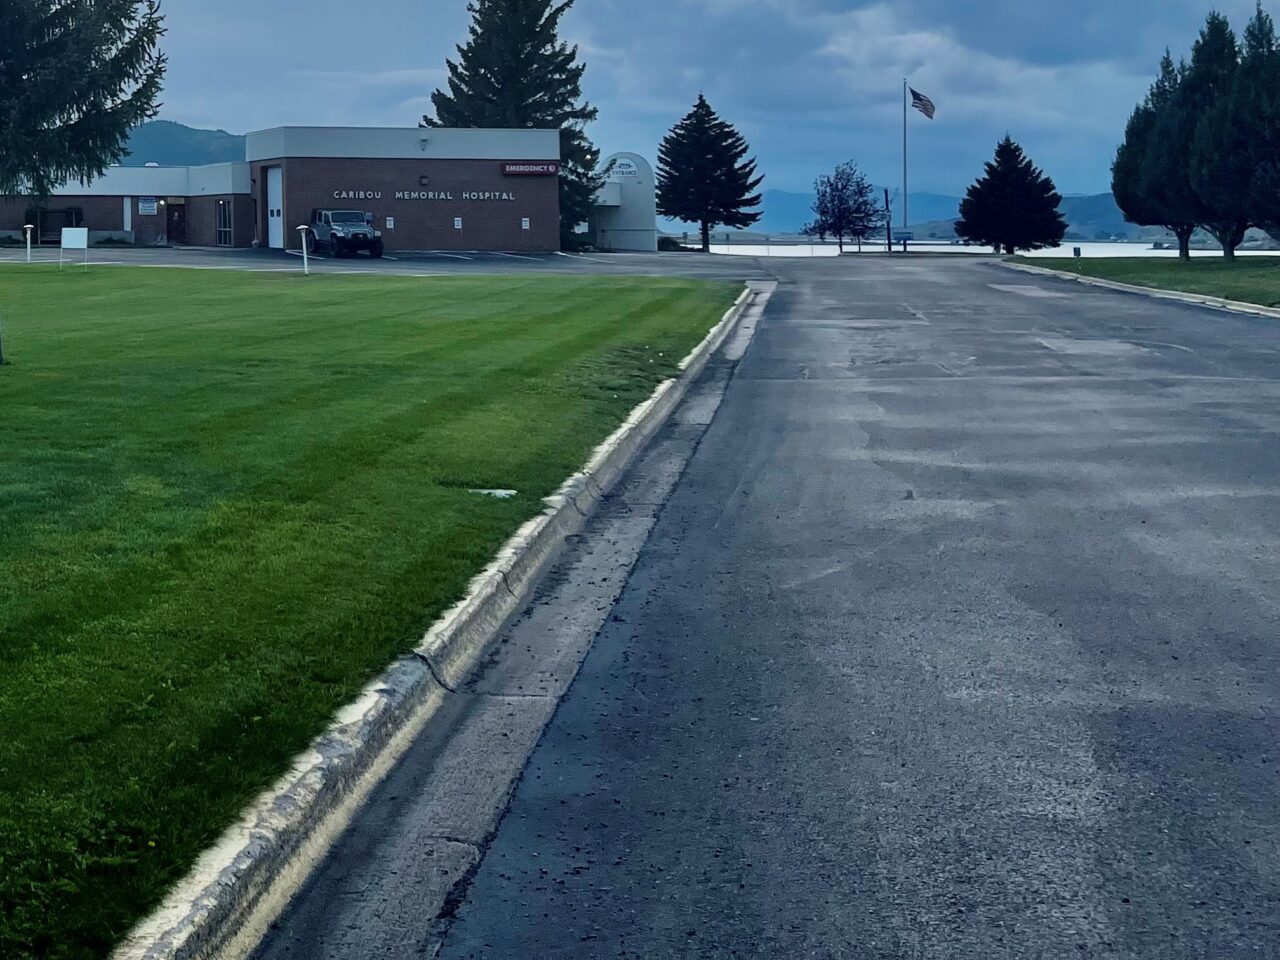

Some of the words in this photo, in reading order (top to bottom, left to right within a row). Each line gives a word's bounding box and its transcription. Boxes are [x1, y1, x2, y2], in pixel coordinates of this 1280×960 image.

[505, 164, 548, 172] EMERGENCY
[333, 191, 381, 199] CARIBOU
[395, 191, 453, 200] MEMORIAL
[462, 192, 515, 201] HOSPITAL
